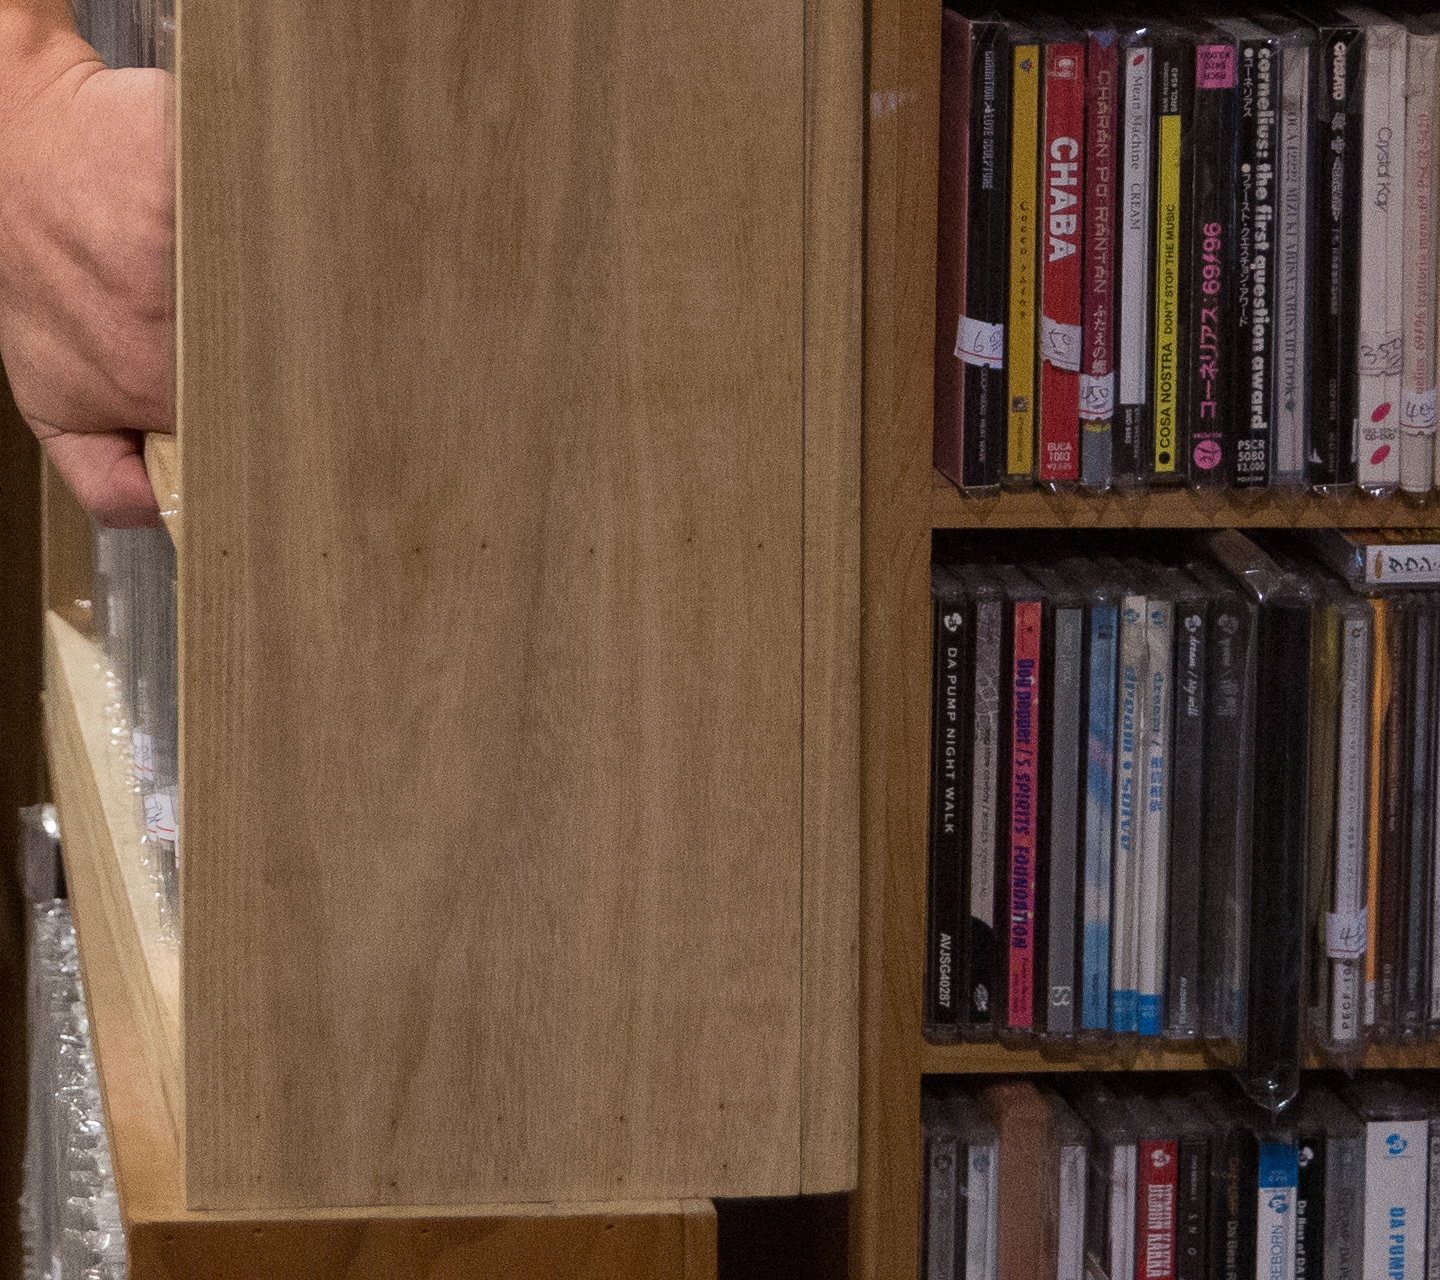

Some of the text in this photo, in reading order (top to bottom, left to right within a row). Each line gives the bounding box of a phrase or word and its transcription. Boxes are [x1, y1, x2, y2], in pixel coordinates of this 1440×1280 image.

[1129, 75, 1144, 231] Mean Machine CREAM
[1375, 127, 1393, 213] Crystal Kay
[1048, 136, 1079, 262] CHABA
[1285, 186, 1299, 238] MIZUKI
[1249, 47, 1274, 429] cornelius: the first question award
[1159, 204, 1177, 449] COSA NOSTRA DON'T STOP THE MUSIC
[1284, 293, 1298, 335] ARISA
[1283, 355, 1296, 399] LOOK
[1046, 443, 1072, 451] BUCA
[1237, 440, 1265, 450] PSCR
[942, 647, 958, 834] DA PUMP NIGHT WALK
[1012, 774, 1031, 835] SPIRITS
[1011, 846, 1031, 948] FOUNDATION
[938, 932, 952, 1008] AVJSG40287
[1146, 1184, 1156, 1278] DEMON KAKKA
[1160, 1184, 1173, 1278] DEMON KAKKA
[1271, 1225, 1283, 1280] REBORN
[1297, 1217, 1307, 1240] Best
[1388, 1207, 1405, 1280] DA PUMP
